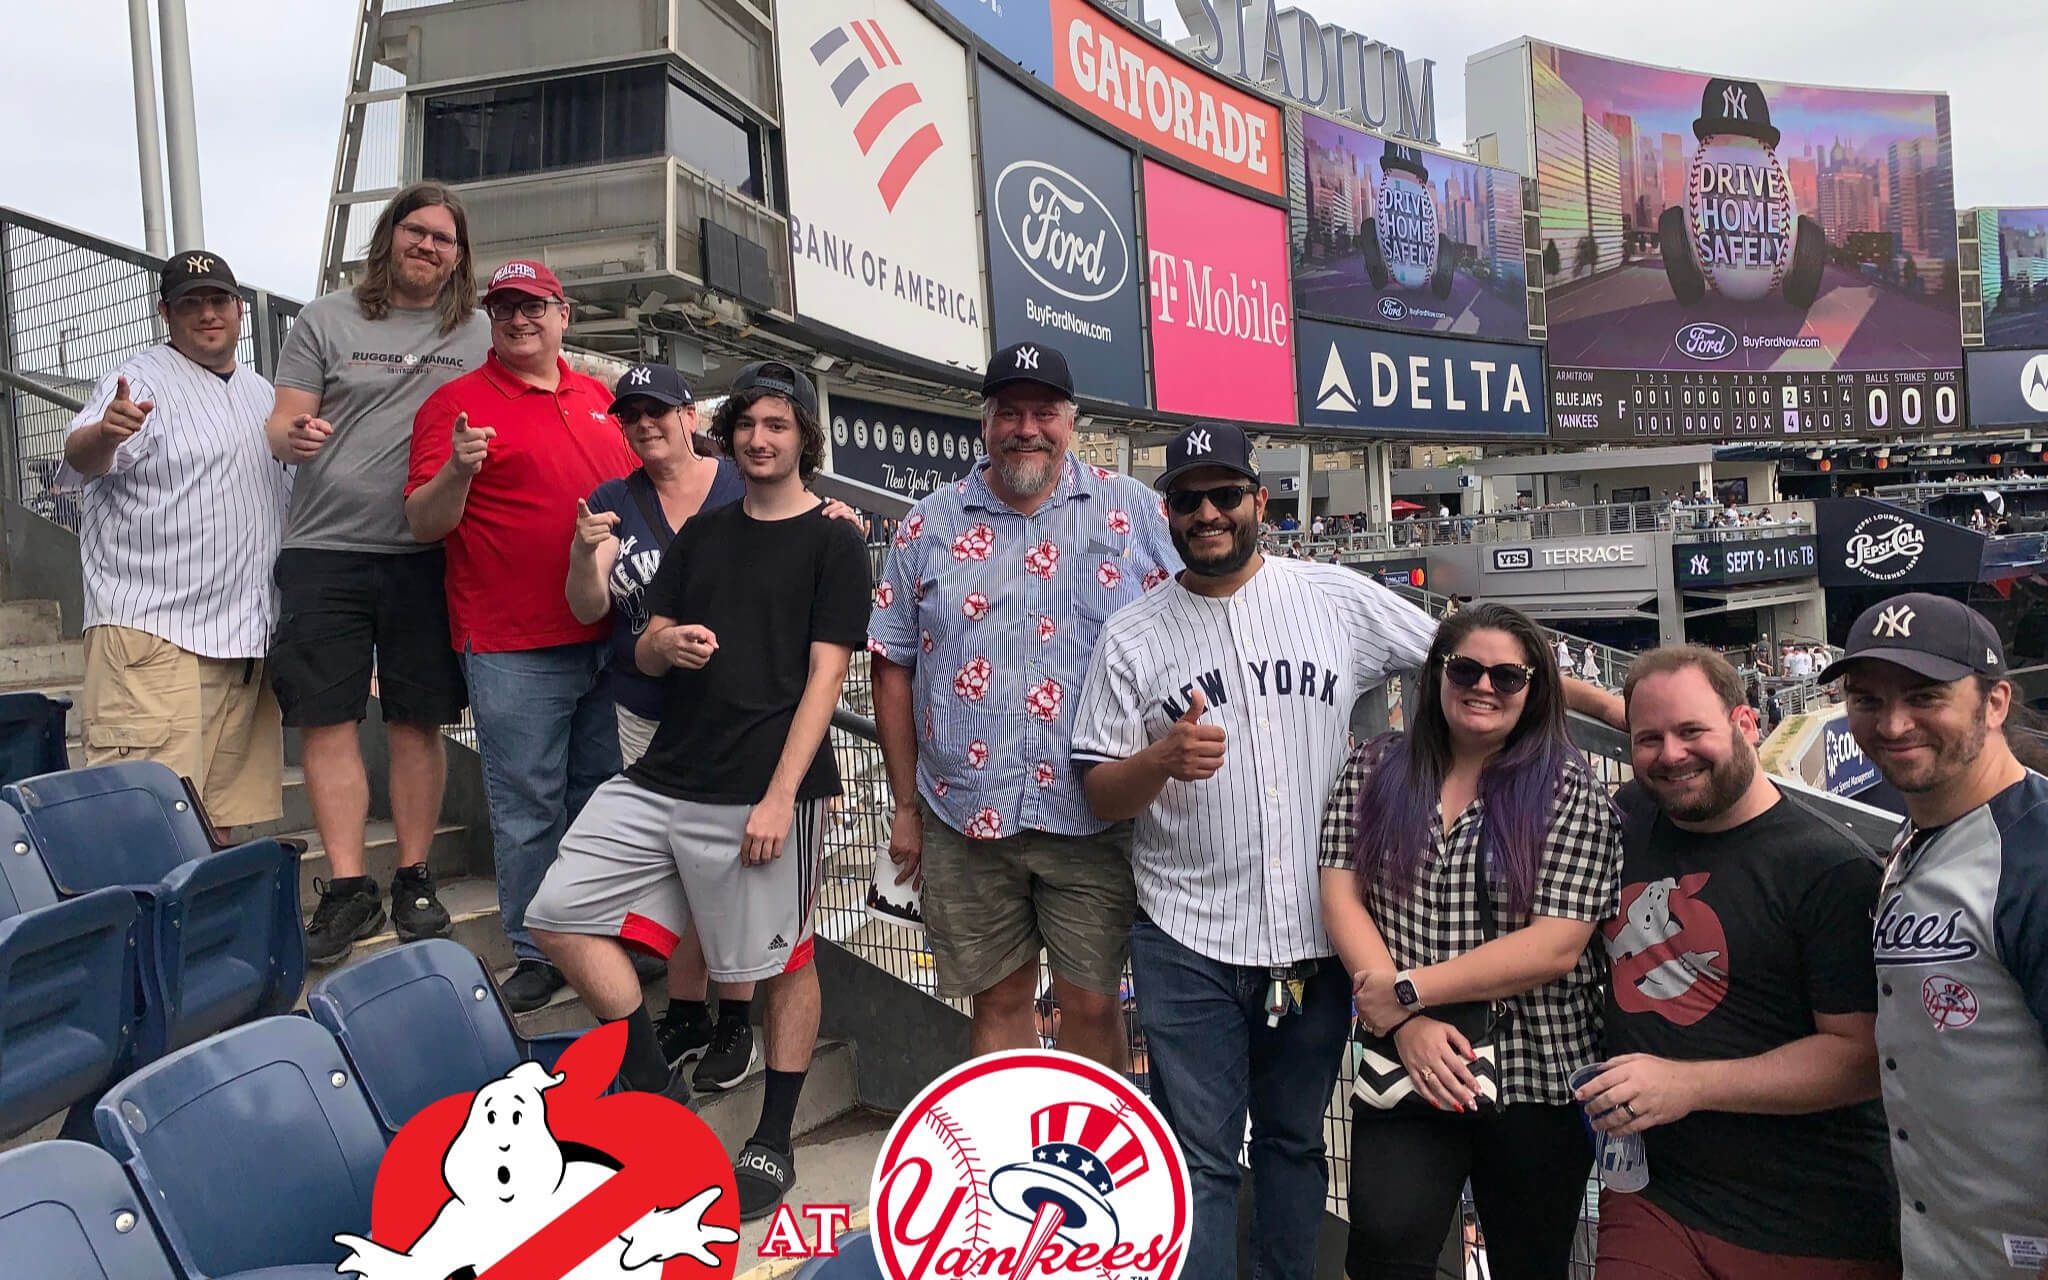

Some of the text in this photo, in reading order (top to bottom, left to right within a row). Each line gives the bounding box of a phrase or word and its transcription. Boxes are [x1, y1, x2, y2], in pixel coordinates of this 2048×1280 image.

[1068, 18, 1268, 176] GATORADE
[1700, 163, 1781, 199] DRIVE
[1383, 187, 1429, 217] DRIVE
[1021, 175, 1107, 286] Ford
[1385, 215, 1430, 242] HOME
[1702, 199, 1781, 234] HOME
[1384, 238, 1433, 266] SAFELY
[1698, 234, 1787, 266] SAFELY
[790, 213, 978, 328] BANK OF AMERICA
[1026, 297, 1112, 343] BuyFordNow.com
[1382, 298, 1402, 318] Ford
[1686, 326, 1820, 354] Ford BuyFordNow.com
[351, 351, 464, 368] RUGGED MANIAC
[1370, 351, 1532, 413] DELTA
[1556, 371, 1594, 382] ARMITRON
[1803, 375, 1809, 384] H
[1821, 375, 1827, 384] E
[1837, 374, 1854, 384] MVR
[1865, 371, 1955, 383] BALLS STRIKES OUTS
[1555, 389, 1850, 407] BLUE JAYS 0 0 1 0 0 0 1 0 0 2 5 1 4
[1618, 400, 1626, 419] F
[1868, 386, 1956, 427] 0 0 0
[838, 423, 844, 439] 3
[858, 426, 864, 441] 5
[877, 429, 883, 443] 7
[894, 431, 903, 446] 37
[1557, 413, 1851, 430] YANKEES 1 0 1 0 0 0 2 0 X 4 6 0 3
[881, 463, 906, 489] New
[905, 466, 930, 499] York
[1854, 513, 1904, 534] PEPSI LOUNGE
[1499, 545, 1634, 565] YES TERRACE
[1726, 550, 1755, 573] SEPT
[1757, 549, 1764, 570] 9
[1774, 547, 1786, 568] 11
[1800, 545, 1814, 566] TB
[1859, 566, 1906, 580] ESTABLISHED
[1248, 659, 1338, 706] YORK
[1874, 892, 1975, 960] kees
[736, 1151, 784, 1183] didas
